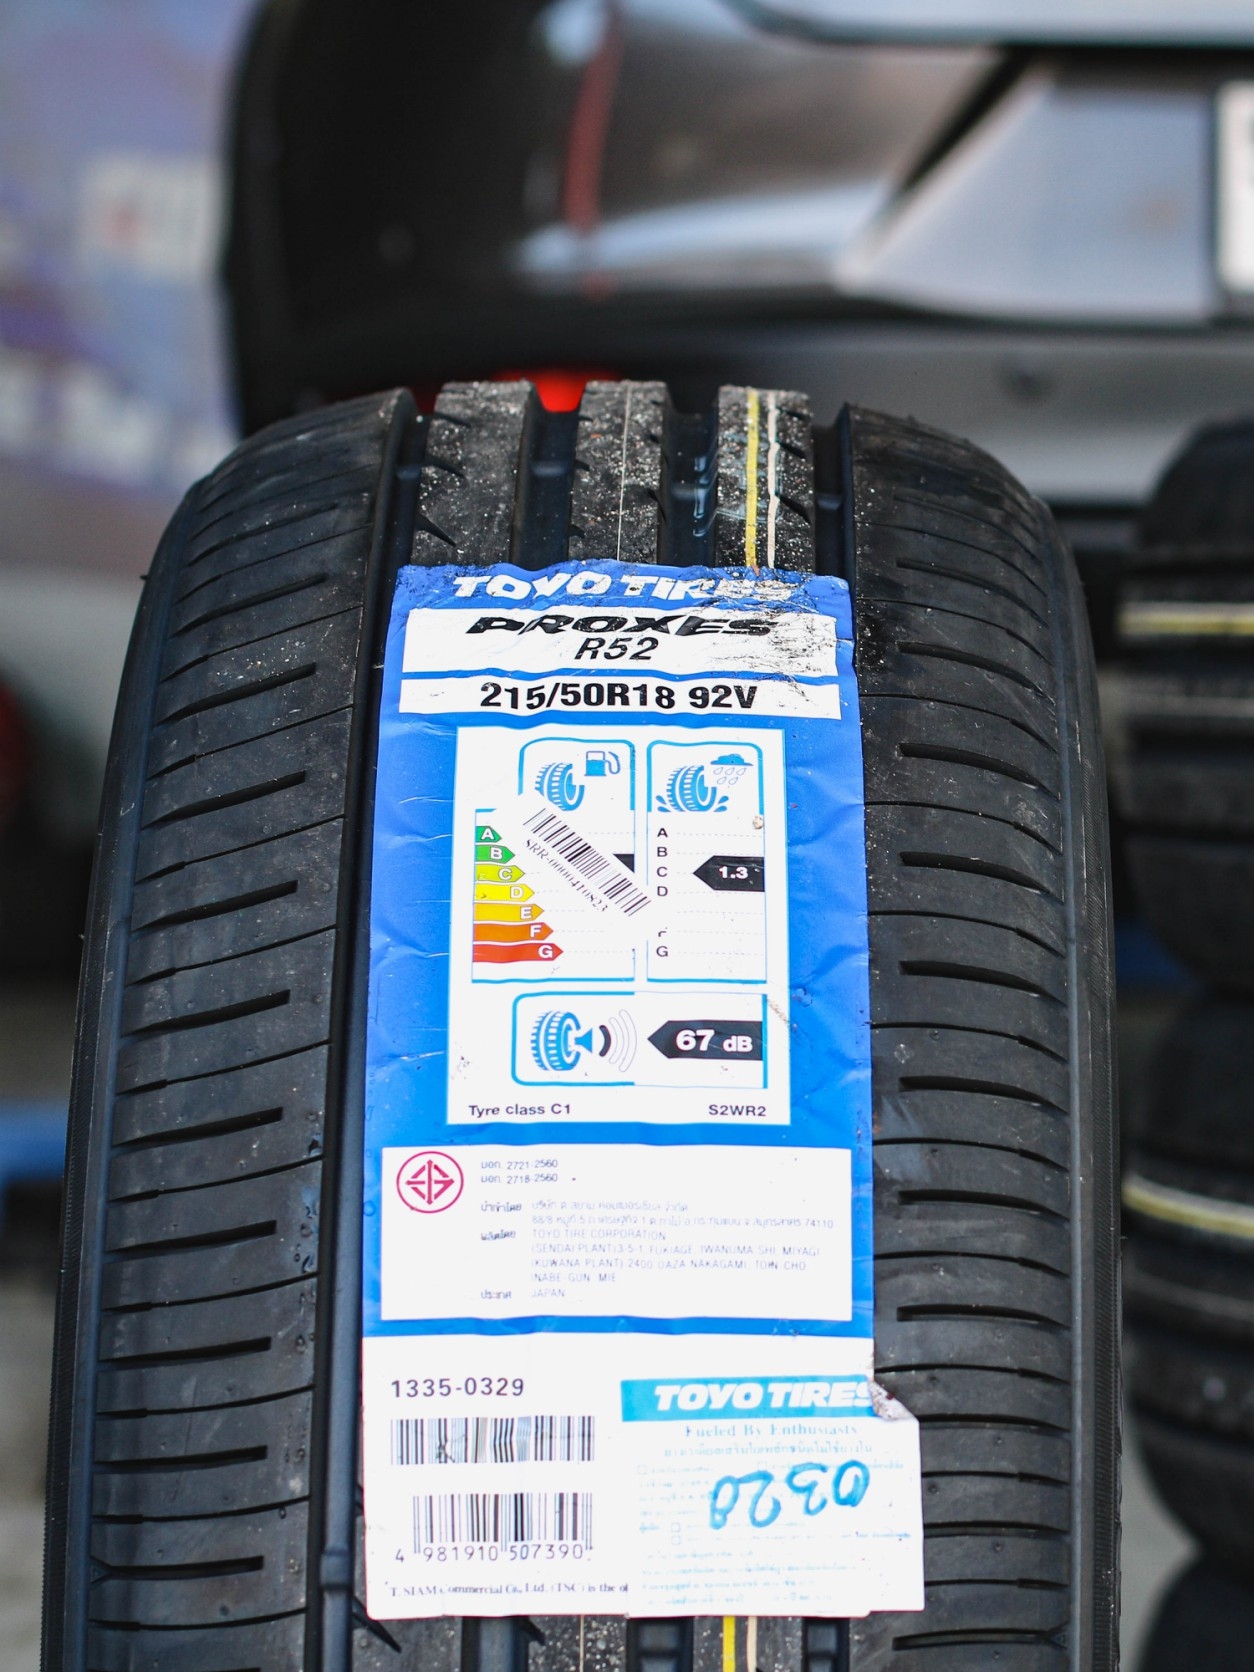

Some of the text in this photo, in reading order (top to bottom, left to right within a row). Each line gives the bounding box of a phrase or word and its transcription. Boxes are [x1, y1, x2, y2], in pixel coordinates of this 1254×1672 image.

[453, 571, 612, 600] TOYO
[465, 614, 779, 636] PROXES
[574, 637, 660, 661] R52
[480, 681, 758, 710] 215/50R18 92V
[480, 827, 496, 842] A
[656, 827, 669, 838] A
[490, 846, 503, 861] B
[656, 846, 668, 857] B
[498, 866, 512, 881] C
[656, 866, 669, 877] C
[718, 865, 749, 880] 1.3
[510, 885, 524, 899] D
[657, 886, 669, 897] D
[520, 906, 533, 920] E
[529, 924, 542, 939] F
[538, 945, 553, 959] G
[656, 945, 669, 957] G
[675, 1029, 754, 1052] 67 dB
[468, 1102, 571, 1118] Tyre class C1
[708, 1104, 767, 1117] S2WR2
[591, 1229, 666, 1240] CORPORATION
[391, 1377, 525, 1398] 1335-0329
[654, 1382, 764, 1411] TOYO
[423, 1544, 499, 1562] 981910
[509, 1543, 584, 1561] 507390
